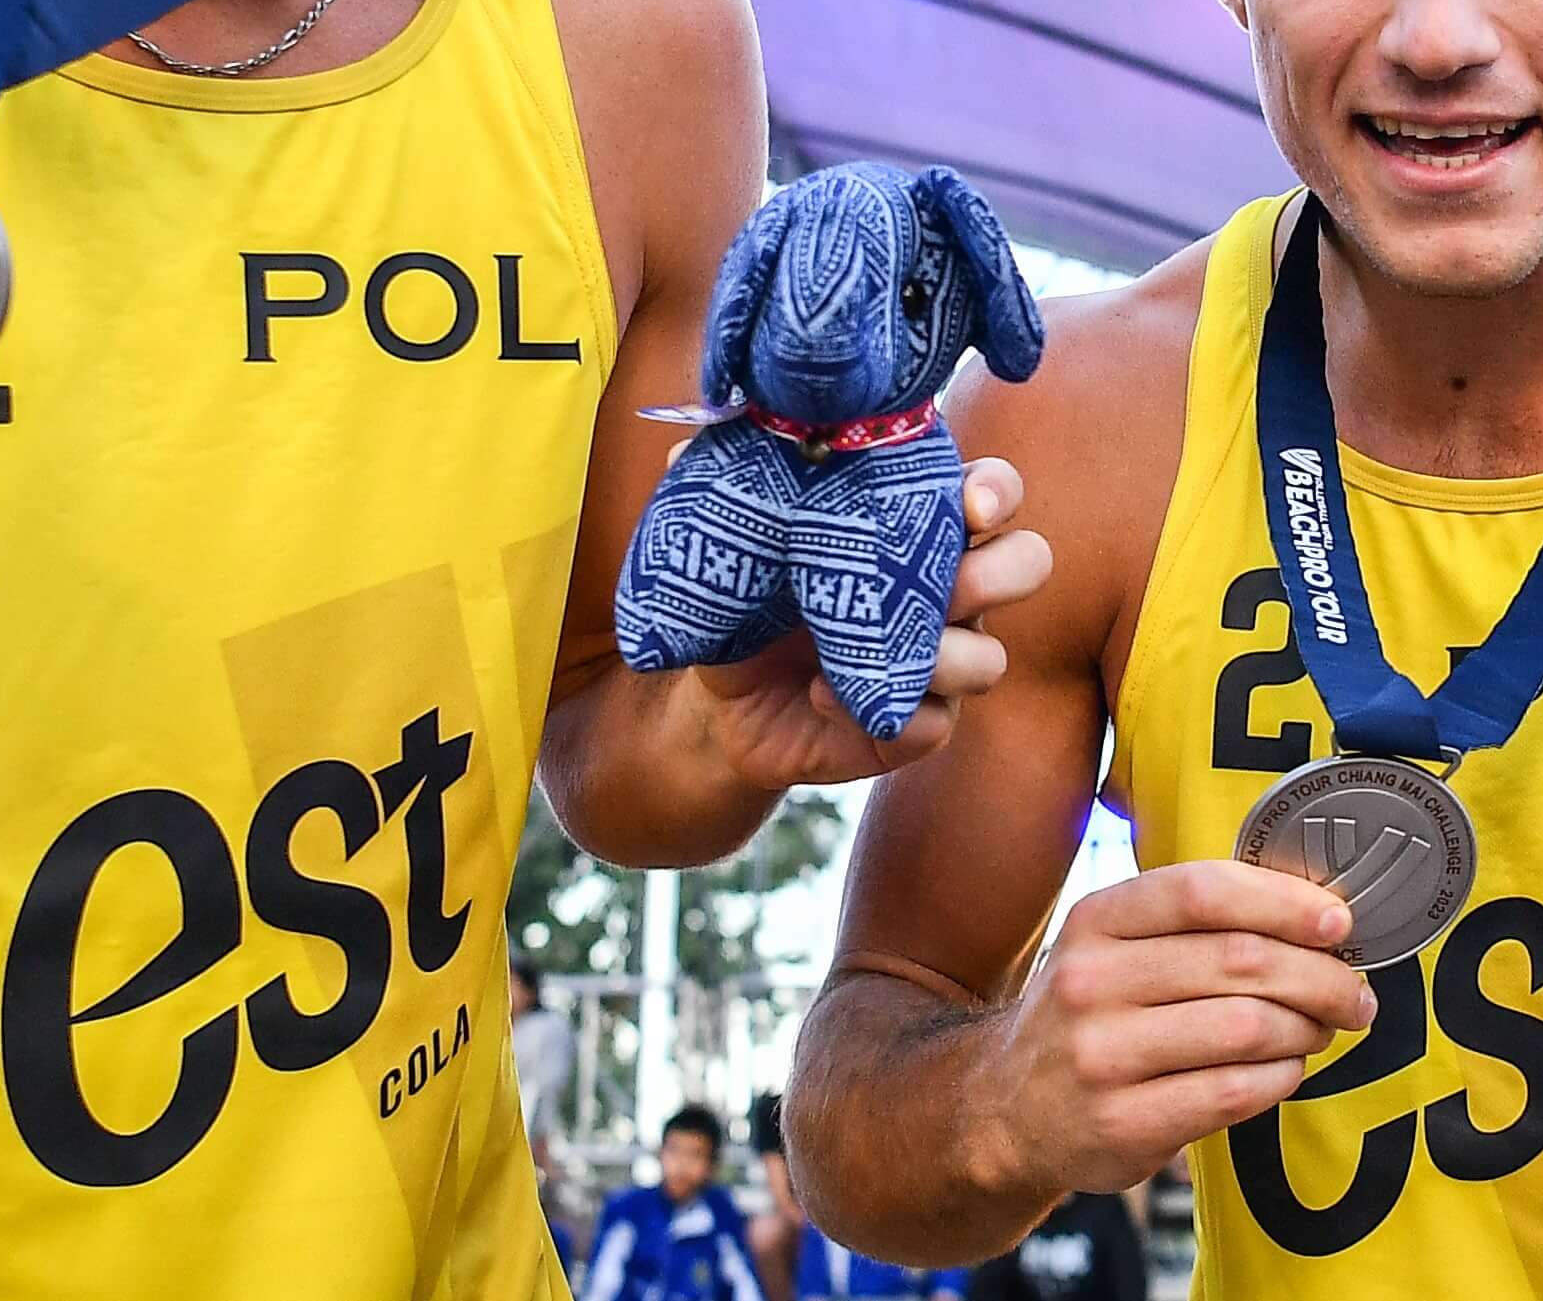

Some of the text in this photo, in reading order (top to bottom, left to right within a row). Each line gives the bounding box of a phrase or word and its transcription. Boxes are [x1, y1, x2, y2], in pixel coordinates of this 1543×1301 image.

[239, 251, 583, 363] POL
[1212, 567, 1312, 771] 2
[1288, 775, 1333, 801] TOUR
[1337, 770, 1397, 786] CHIANG
[1398, 779, 1424, 801] MAI
[1262, 800, 1290, 828] PRO
[1244, 828, 1270, 866] EACH
[1423, 796, 1462, 875] CHALLENGE
[1427, 888, 1454, 920] 2023
[2, 706, 474, 1188] est
[378, 1002, 471, 1120] COLA
